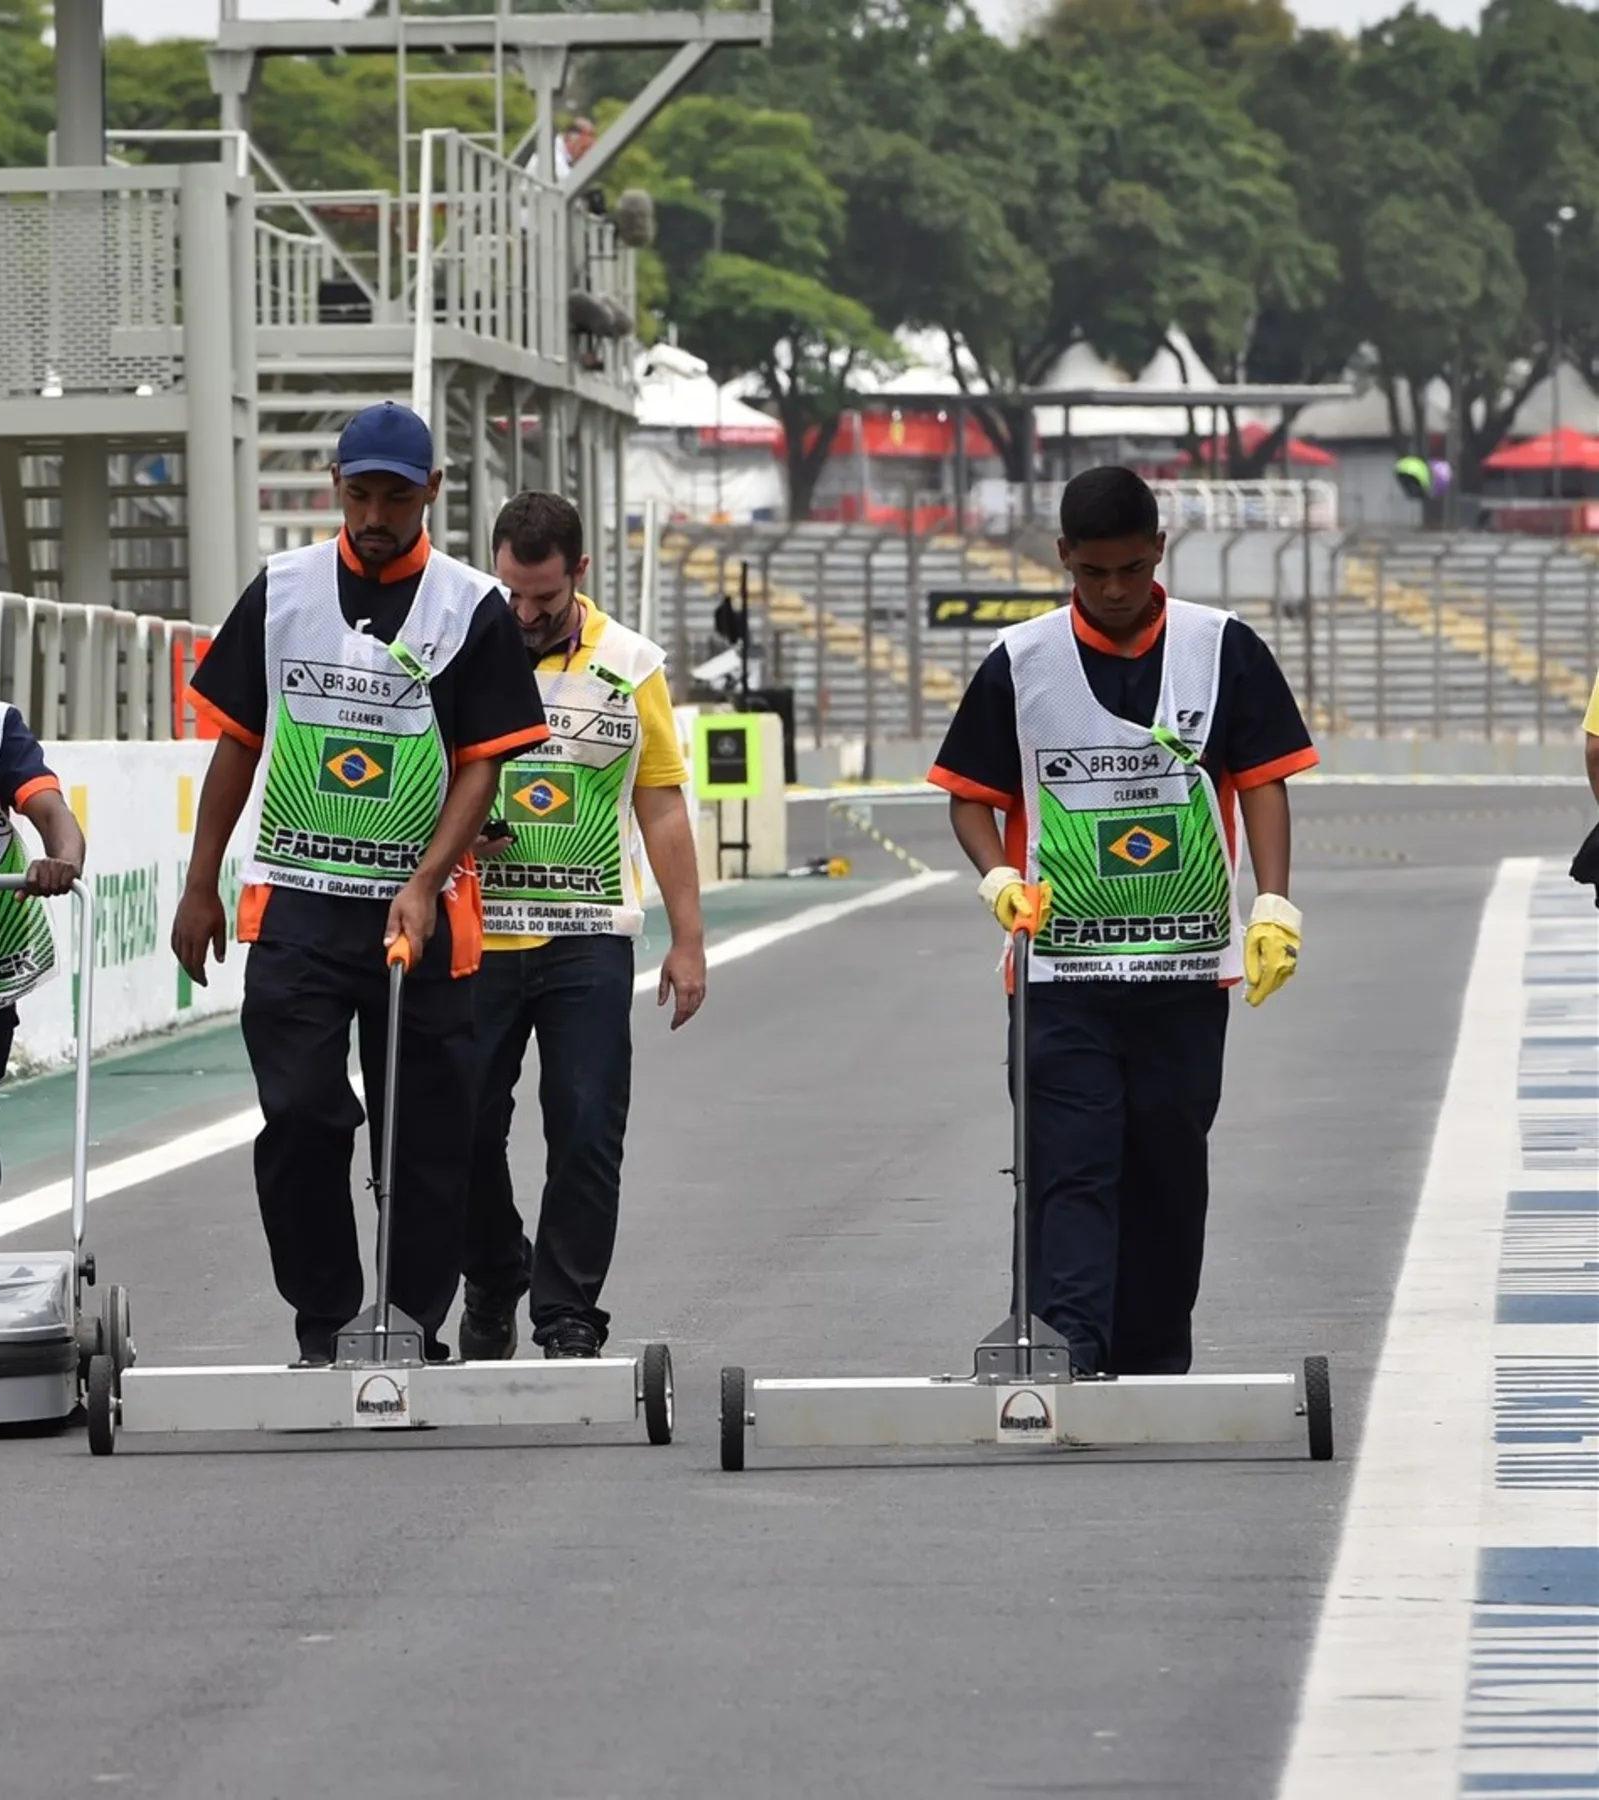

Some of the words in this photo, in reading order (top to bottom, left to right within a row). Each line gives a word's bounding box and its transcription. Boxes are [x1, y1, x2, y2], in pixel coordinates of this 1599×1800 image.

[338, 709, 384, 727] CLEANER
[596, 719, 632, 740] 2015
[1114, 787, 1159, 802] CLEANER
[272, 826, 423, 870] PADDOCK
[267, 871, 315, 890] FORMULA
[318, 880, 324, 890] 1
[327, 880, 375, 897] GRANDE
[482, 905, 514, 918] MULA
[517, 907, 523, 917] 1
[527, 907, 572, 919] GRANDE
[528, 920, 544, 931] DO
[547, 920, 587, 932] BRASIL
[591, 920, 613, 932] 2015
[1051, 912, 1221, 946] PADDOCK
[1054, 961, 1114, 974] FORMULA
[1118, 962, 1123, 972] 1
[1129, 960, 1173, 973] GRANDE
